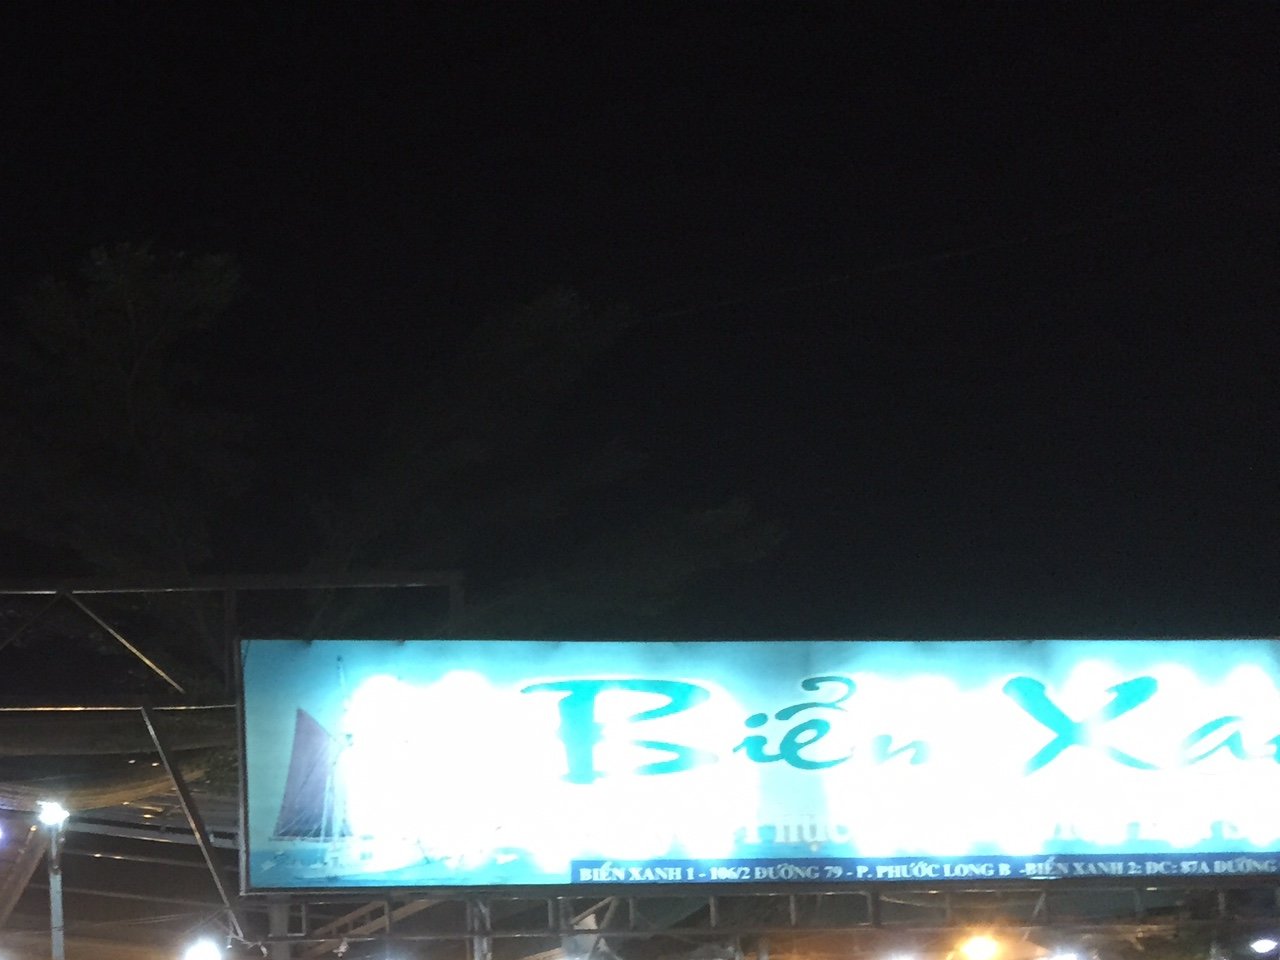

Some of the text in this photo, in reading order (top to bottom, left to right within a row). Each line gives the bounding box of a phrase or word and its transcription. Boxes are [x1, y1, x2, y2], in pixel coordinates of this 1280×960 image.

[521, 676, 1280, 785] Biển Xa
[628, 866, 682, 881] XANH
[686, 867, 695, 880] 1
[824, 865, 842, 879] 79
[856, 864, 873, 878] P.
[876, 861, 940, 879] PHƯỚC
[943, 862, 995, 877] LONG
[999, 862, 1012, 876] B
[1072, 862, 1124, 875] XANH
